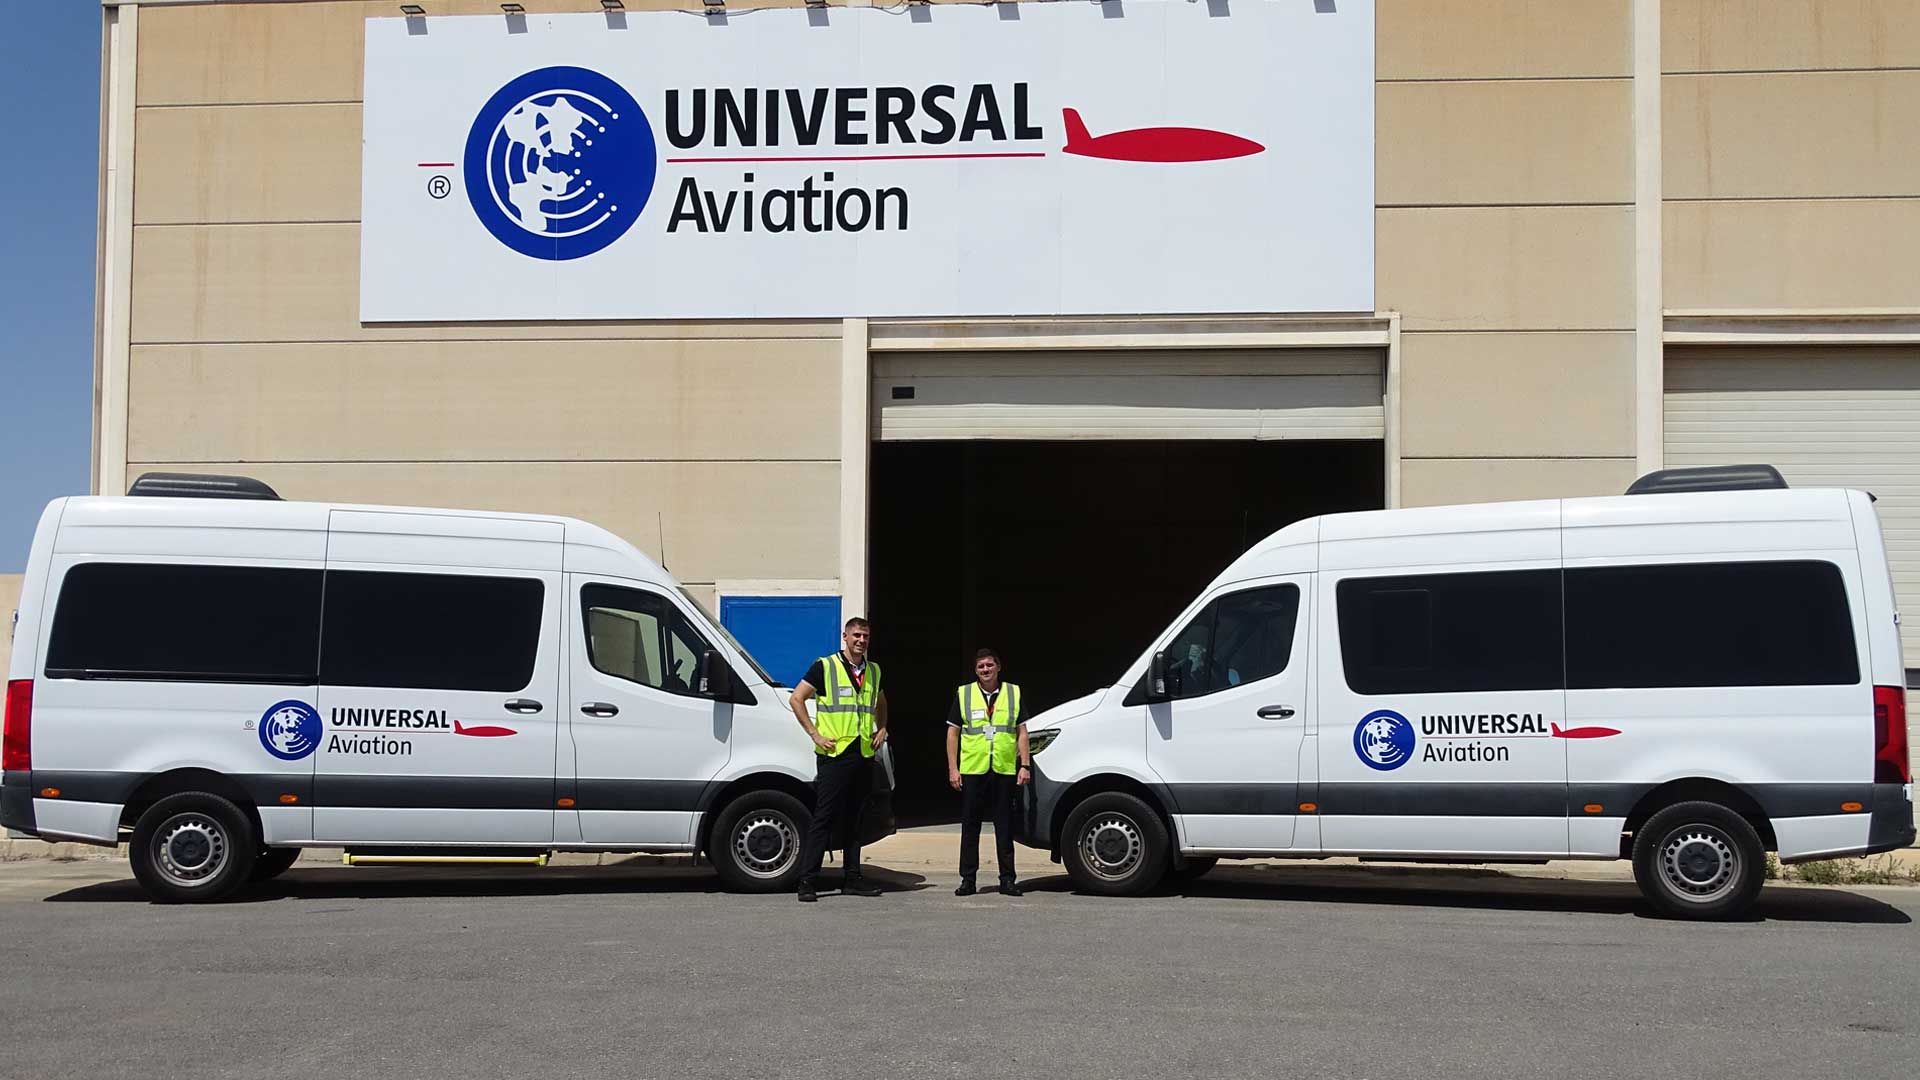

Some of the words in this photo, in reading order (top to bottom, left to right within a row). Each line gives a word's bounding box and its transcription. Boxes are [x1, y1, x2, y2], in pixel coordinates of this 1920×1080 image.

[665, 82, 1043, 149] UNIVERSAL
[666, 171, 908, 233] Aviation
[331, 707, 451, 729] UNIVERSAL
[1421, 713, 1548, 736] UNIVERSAL
[327, 734, 412, 755] Aviation
[1422, 741, 1509, 762] Aviation
